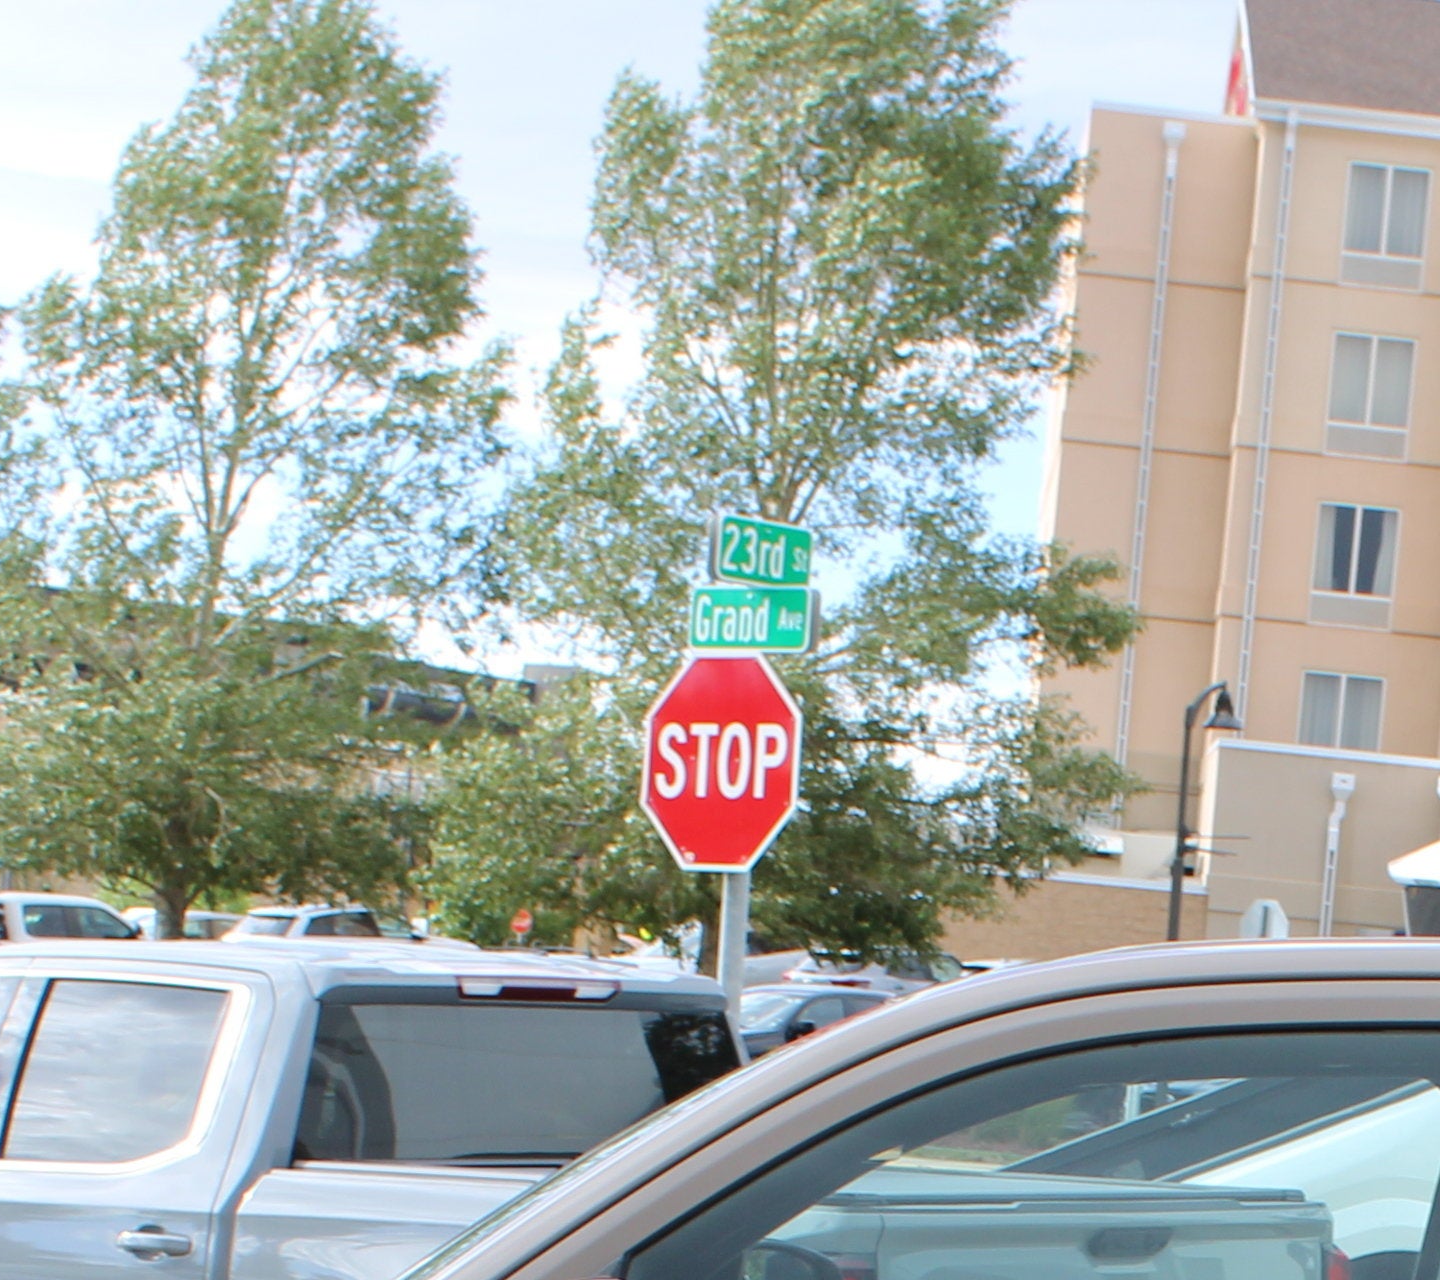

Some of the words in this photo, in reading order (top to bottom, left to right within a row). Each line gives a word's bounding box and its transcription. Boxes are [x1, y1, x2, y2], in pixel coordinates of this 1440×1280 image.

[721, 522, 787, 580] 23rd
[695, 594, 770, 643] Grand
[777, 612, 804, 632] Ave
[654, 722, 789, 801] STOP
